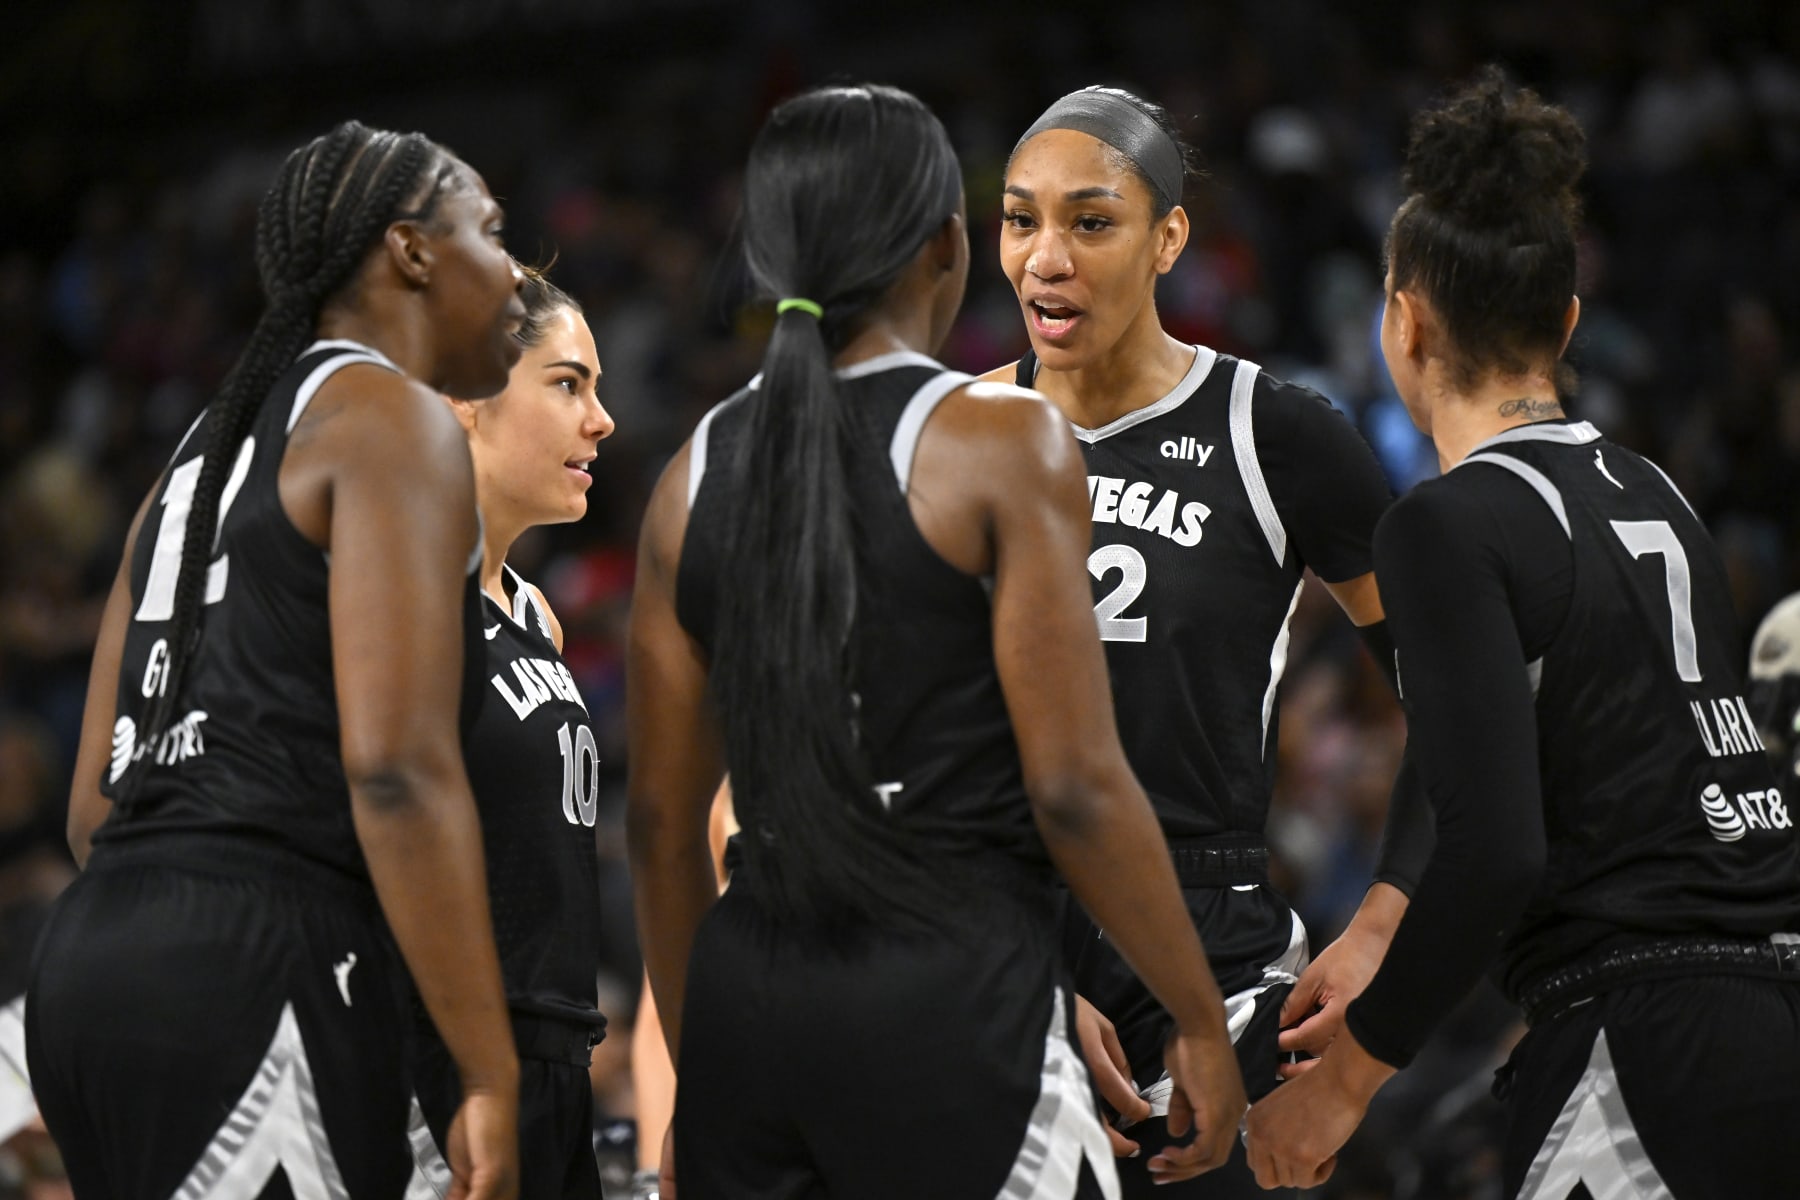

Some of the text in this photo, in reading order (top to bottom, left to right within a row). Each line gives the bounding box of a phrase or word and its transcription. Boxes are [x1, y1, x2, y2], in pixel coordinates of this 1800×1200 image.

[1160, 436, 1214, 467] ally
[1609, 519, 1703, 682] 7
[490, 657, 552, 721] LAS
[557, 721, 600, 828] 10
[1736, 788, 1793, 830] AT&
